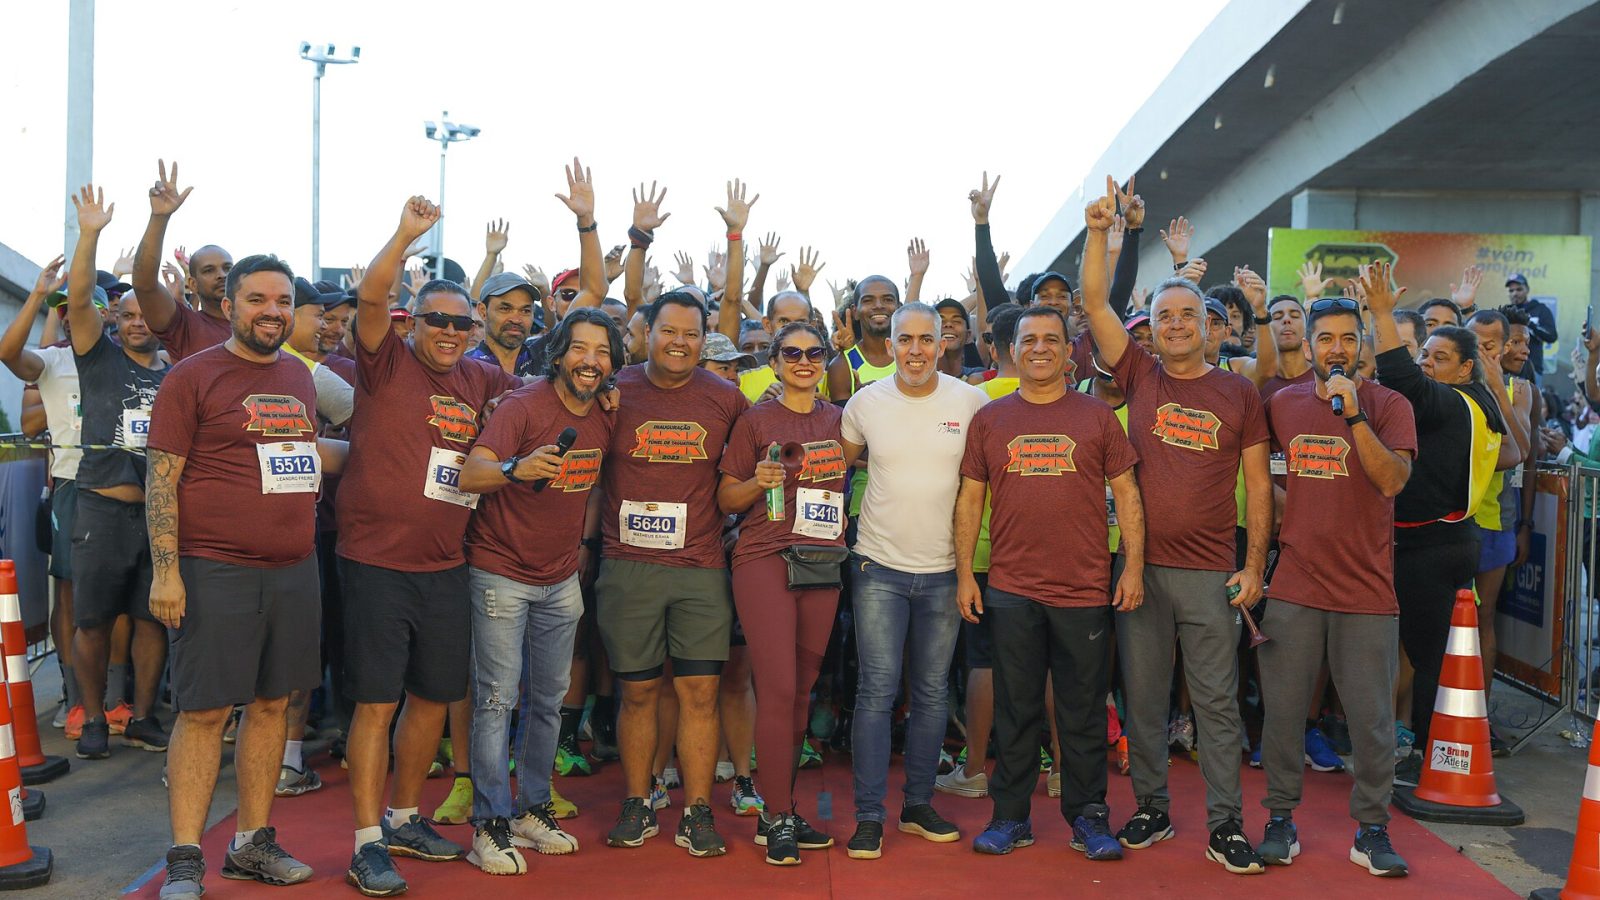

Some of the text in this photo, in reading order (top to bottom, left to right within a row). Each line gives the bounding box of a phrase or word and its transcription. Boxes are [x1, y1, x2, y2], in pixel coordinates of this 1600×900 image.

[135, 422, 150, 432] 51
[275, 457, 312, 473] 5512
[440, 468, 459, 485] 57
[632, 516, 671, 531] 5640
[1517, 563, 1542, 592] GDF
[1447, 746, 1469, 758] Bruno
[1444, 756, 1469, 768] Atleta
